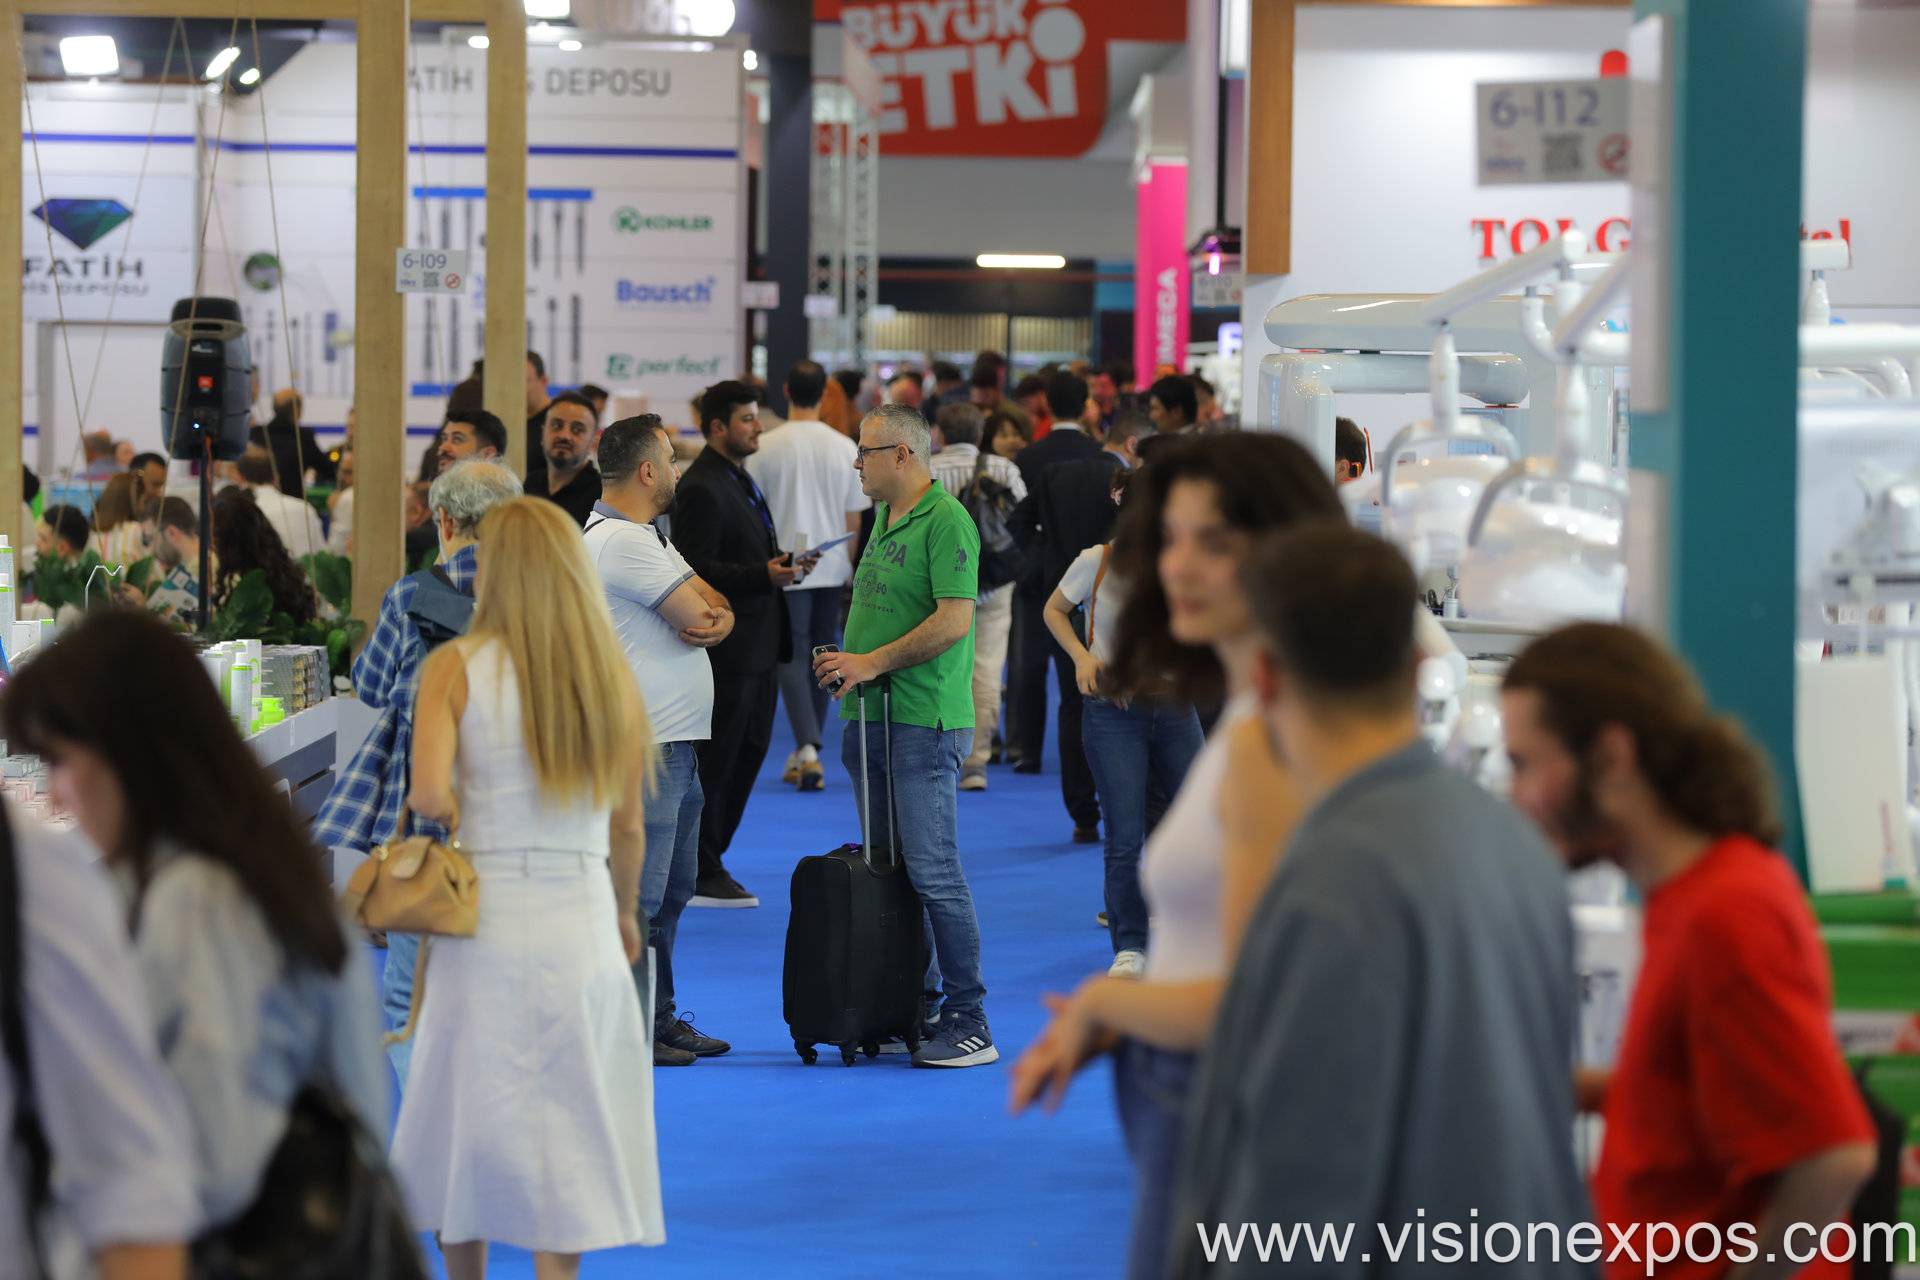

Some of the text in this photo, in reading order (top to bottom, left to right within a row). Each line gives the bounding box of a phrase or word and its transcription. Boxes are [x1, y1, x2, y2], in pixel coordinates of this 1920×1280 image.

[843, 0, 1026, 49] BÜYÜK
[407, 61, 474, 93] ATİH
[545, 66, 672, 97] DEPOSU
[25, 252, 142, 278] FATİH
